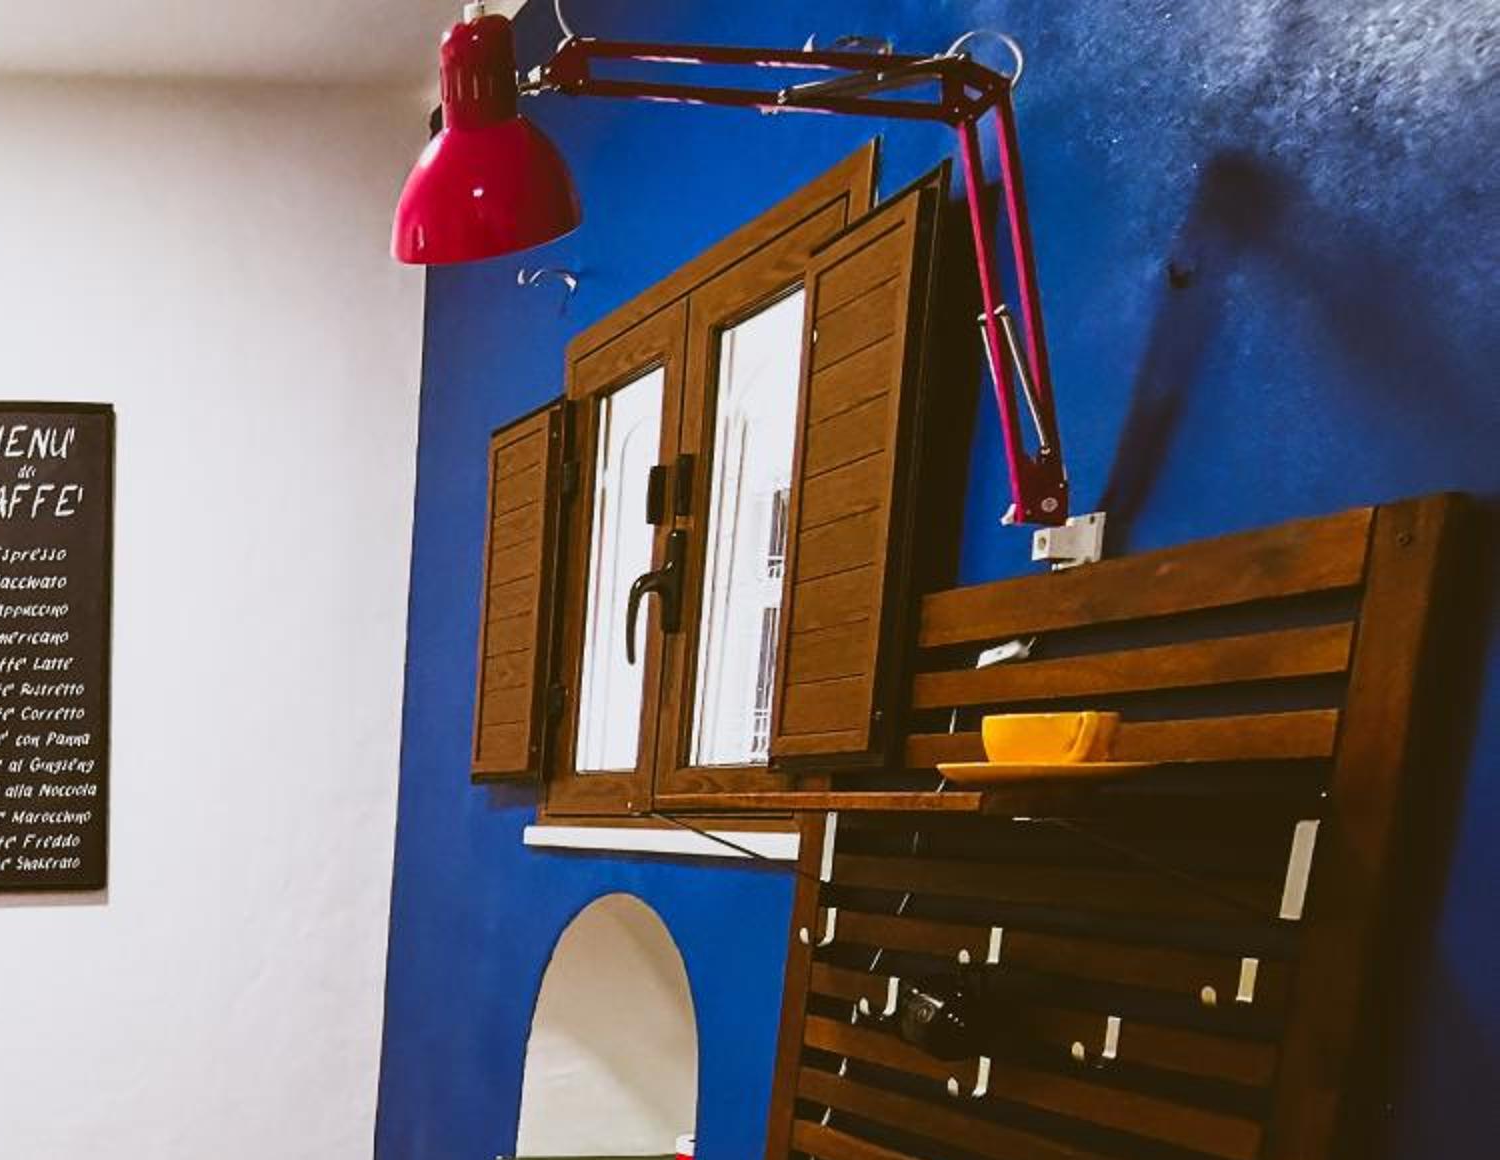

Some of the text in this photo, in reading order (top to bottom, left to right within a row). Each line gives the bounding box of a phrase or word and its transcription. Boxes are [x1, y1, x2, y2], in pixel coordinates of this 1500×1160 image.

[20, 683, 84, 696] Ristretto
[22, 706, 85, 720] Corretto
[16, 734, 40, 747] con
[46, 732, 90, 747] Panna
[8, 759, 22, 772] al
[5, 785, 33, 798] alla
[38, 783, 96, 797] Nocciola
[12, 811, 92, 825] Marocchino
[23, 833, 81, 848] Freddo
[16, 856, 81, 871] Shakerato
